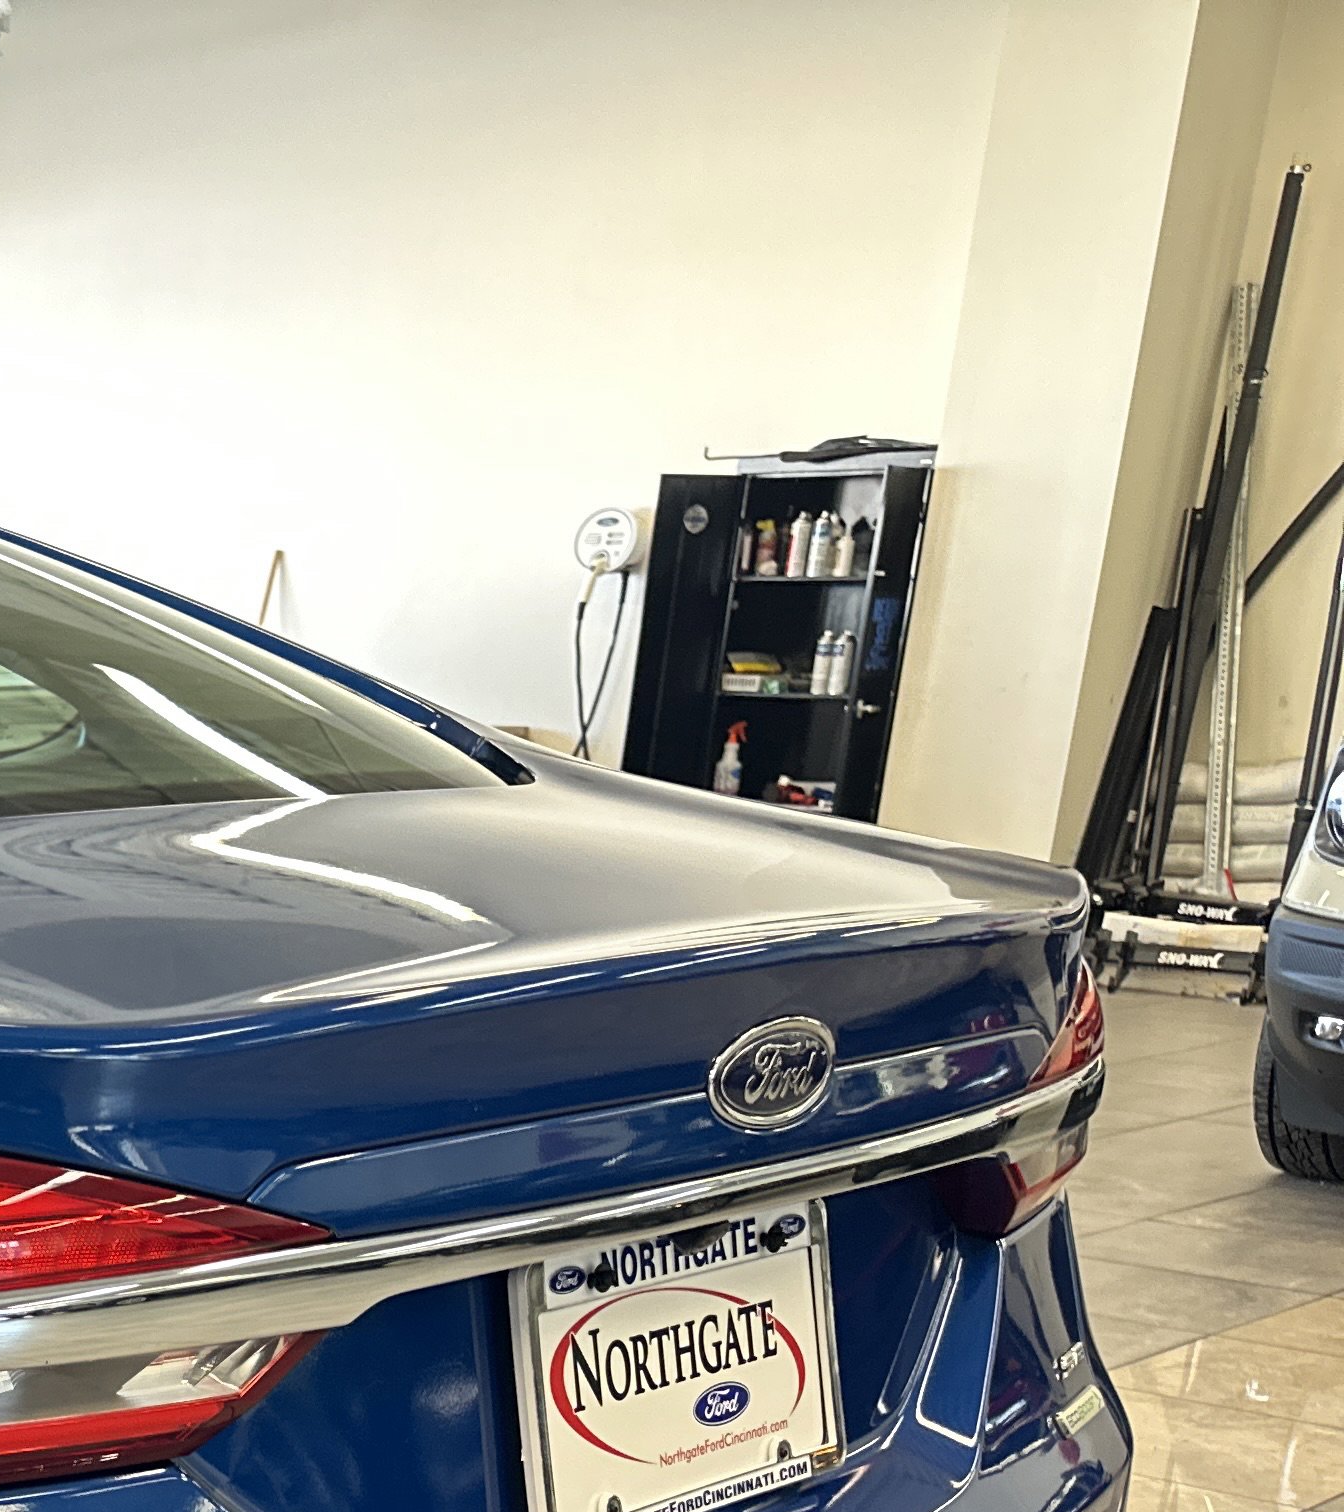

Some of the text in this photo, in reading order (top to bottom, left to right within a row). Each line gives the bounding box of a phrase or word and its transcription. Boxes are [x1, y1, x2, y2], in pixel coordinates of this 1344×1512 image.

[744, 1041, 817, 1104] Ford
[570, 1299, 778, 1413] NORTHGATE
[704, 1388, 739, 1421] Ford
[659, 1419, 788, 1468] NorthgateFordCincinnati.com
